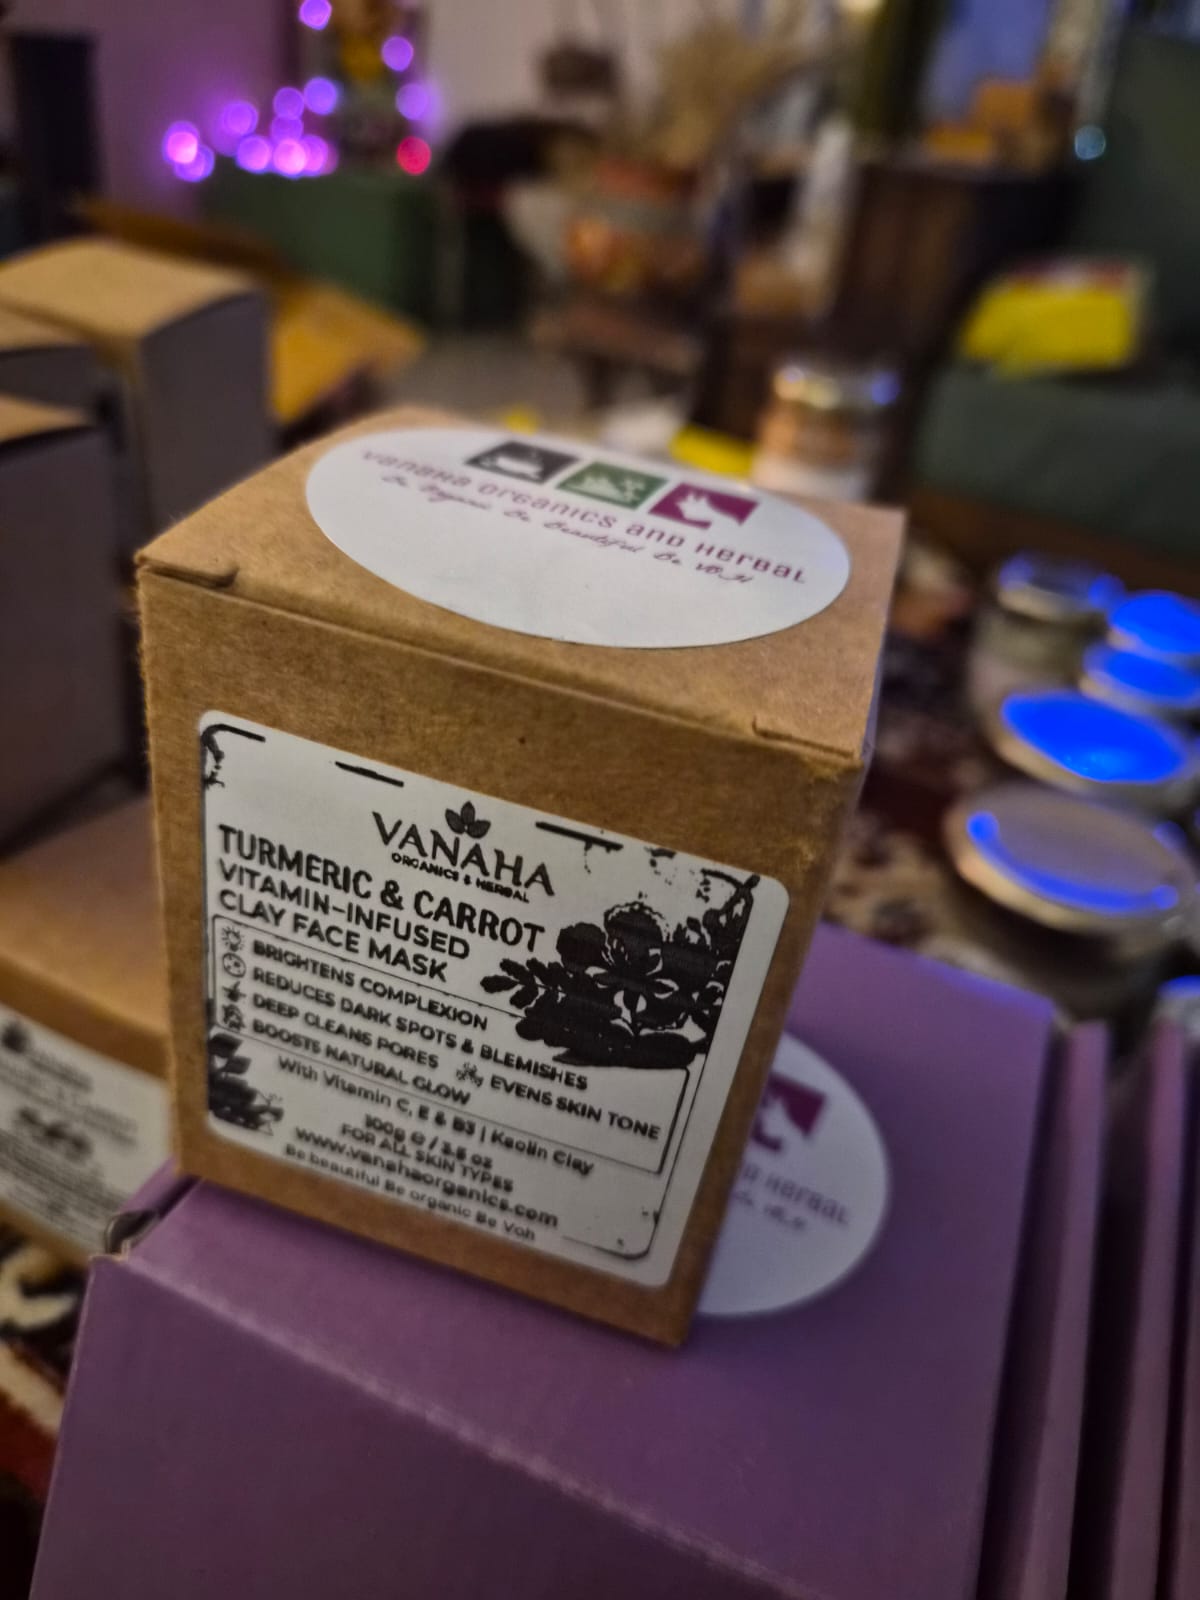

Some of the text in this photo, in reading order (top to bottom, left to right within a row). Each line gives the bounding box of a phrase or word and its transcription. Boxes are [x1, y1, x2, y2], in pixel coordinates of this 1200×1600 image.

[218, 824, 545, 952] TURMERIC & CARROT
[372, 811, 555, 896] VANAHA
[391, 853, 459, 881] ORGANICS
[476, 878, 529, 903] HERBAL
[219, 858, 470, 959] VITAMIN-INFUSED
[219, 889, 446, 982] CLAY FACE MASK
[253, 940, 487, 1031] BRIGHTENS COMPLEXION
[254, 966, 588, 1090] REDUCES DARK SPOTS & BLEMISHES
[253, 993, 438, 1068] DEEP CLEANS PORES
[253, 1018, 470, 1105] BOOSTS NATURAL GLOW
[278, 1055, 318, 1081] With
[323, 1070, 391, 1107] Vitamin
[491, 1129, 547, 1159] Kaolin
[553, 1150, 593, 1176] Clay
[490, 1075, 661, 1141] EVENS SKIN TONE
[295, 1126, 558, 1228] www.vanahaorganics.com
[342, 1123, 513, 1193] FOR ALL SKIN TYPES
[410, 1189, 471, 1218] organic
